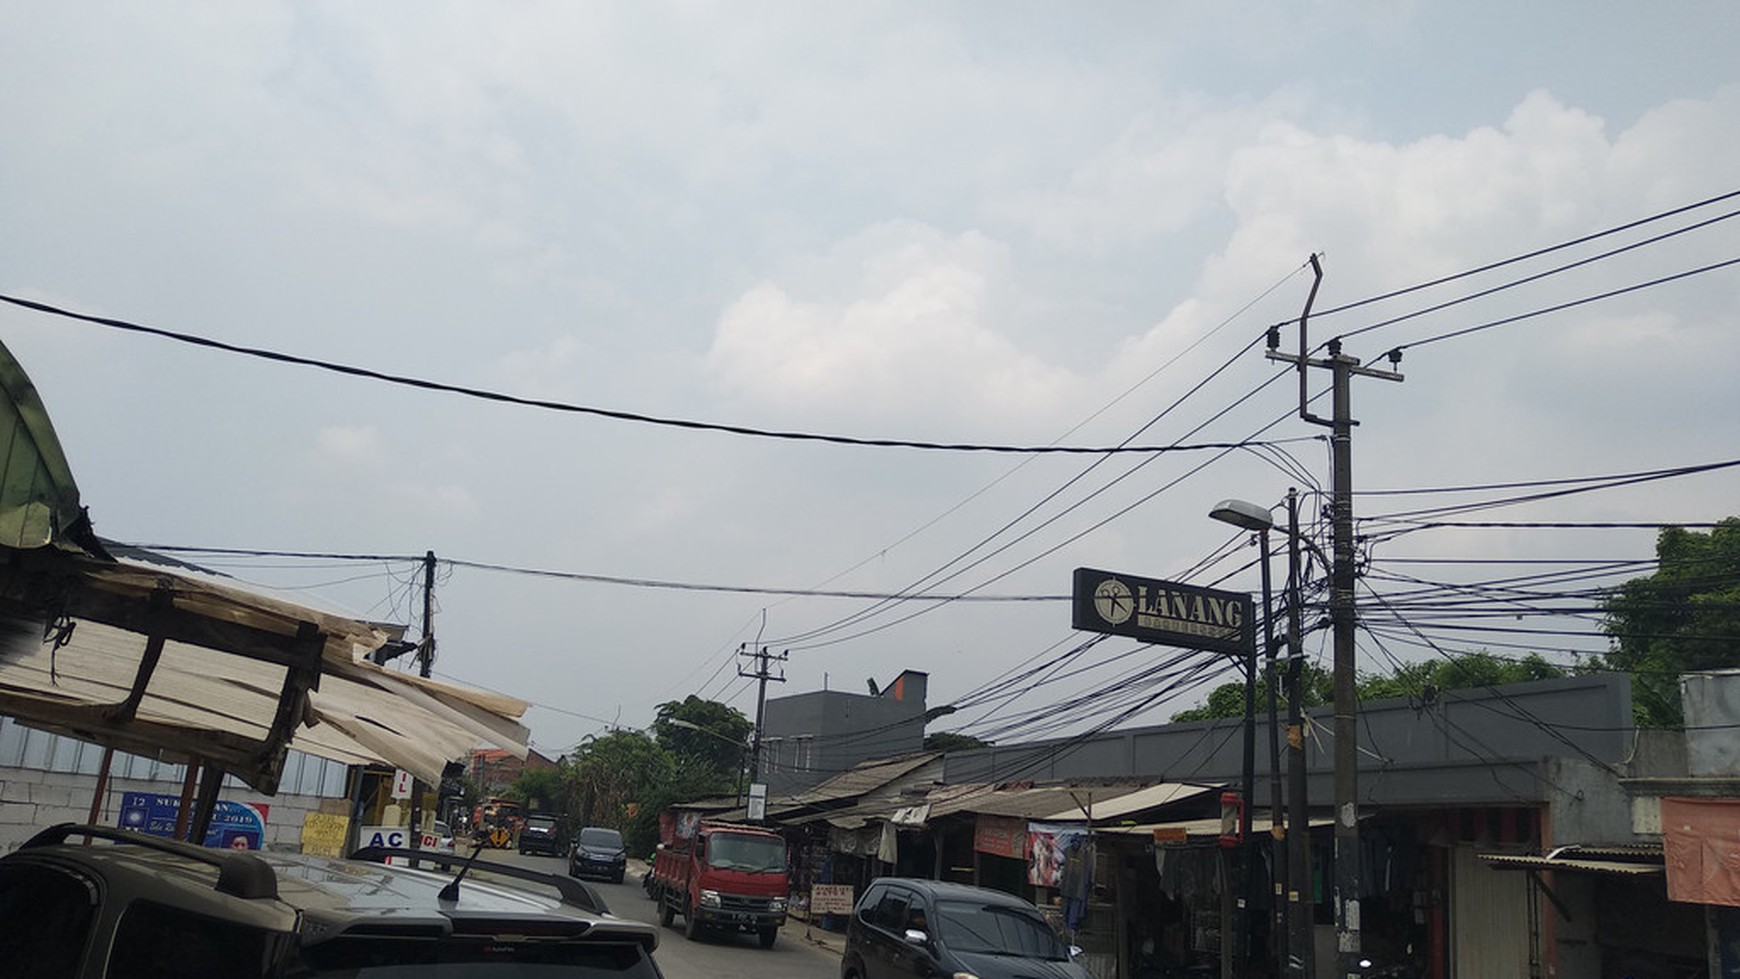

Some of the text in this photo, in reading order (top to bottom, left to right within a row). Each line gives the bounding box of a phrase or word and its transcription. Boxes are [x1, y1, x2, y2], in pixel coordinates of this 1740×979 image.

[1137, 585, 1242, 628] LANANG
[132, 797, 145, 806] 12
[223, 814, 252, 823] 2019
[369, 831, 403, 848] AC
